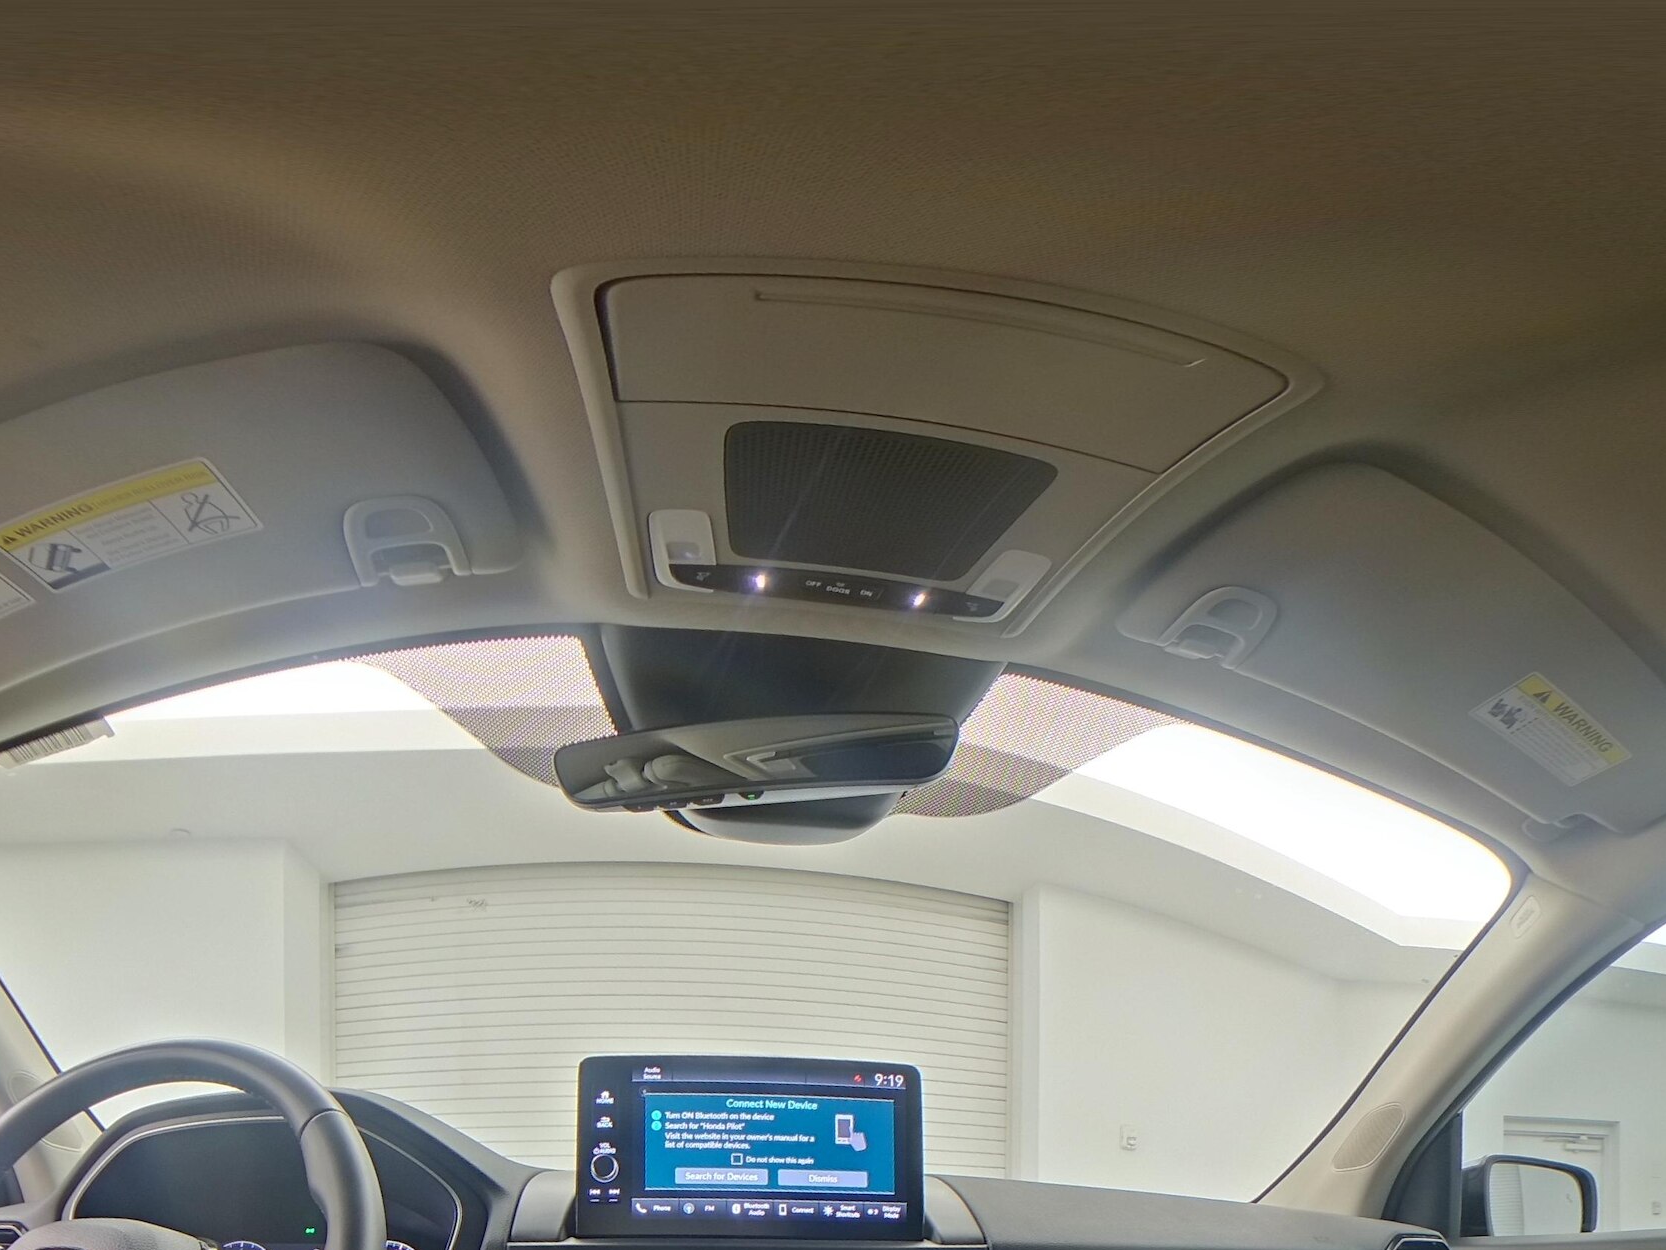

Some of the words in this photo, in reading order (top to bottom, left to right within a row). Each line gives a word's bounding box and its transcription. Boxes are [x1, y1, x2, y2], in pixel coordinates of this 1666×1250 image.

[15, 503, 93, 537] WARNING
[1554, 702, 1613, 752] WARNING
[874, 1073, 904, 1087] 9:19
[726, 1099, 764, 1108] Connect
[765, 1100, 786, 1109] New
[788, 1100, 818, 1110] Device
[664, 1111, 680, 1119] Turn
[695, 1112, 728, 1120] Bluetooth
[740, 1112, 751, 1120] the
[700, 1122, 725, 1130] "Honda
[664, 1132, 680, 1140] Visit
[682, 1132, 693, 1140] the
[729, 1134, 745, 1142] your
[746, 1134, 773, 1142] owner's
[774, 1134, 798, 1142] manual
[799, 1134, 809, 1142] for
[685, 1142, 722, 1150] compatible
[685, 1172, 711, 1180] Search
[713, 1172, 725, 1180] for
[727, 1173, 758, 1181] Devices
[809, 1174, 837, 1183] Dismiss
